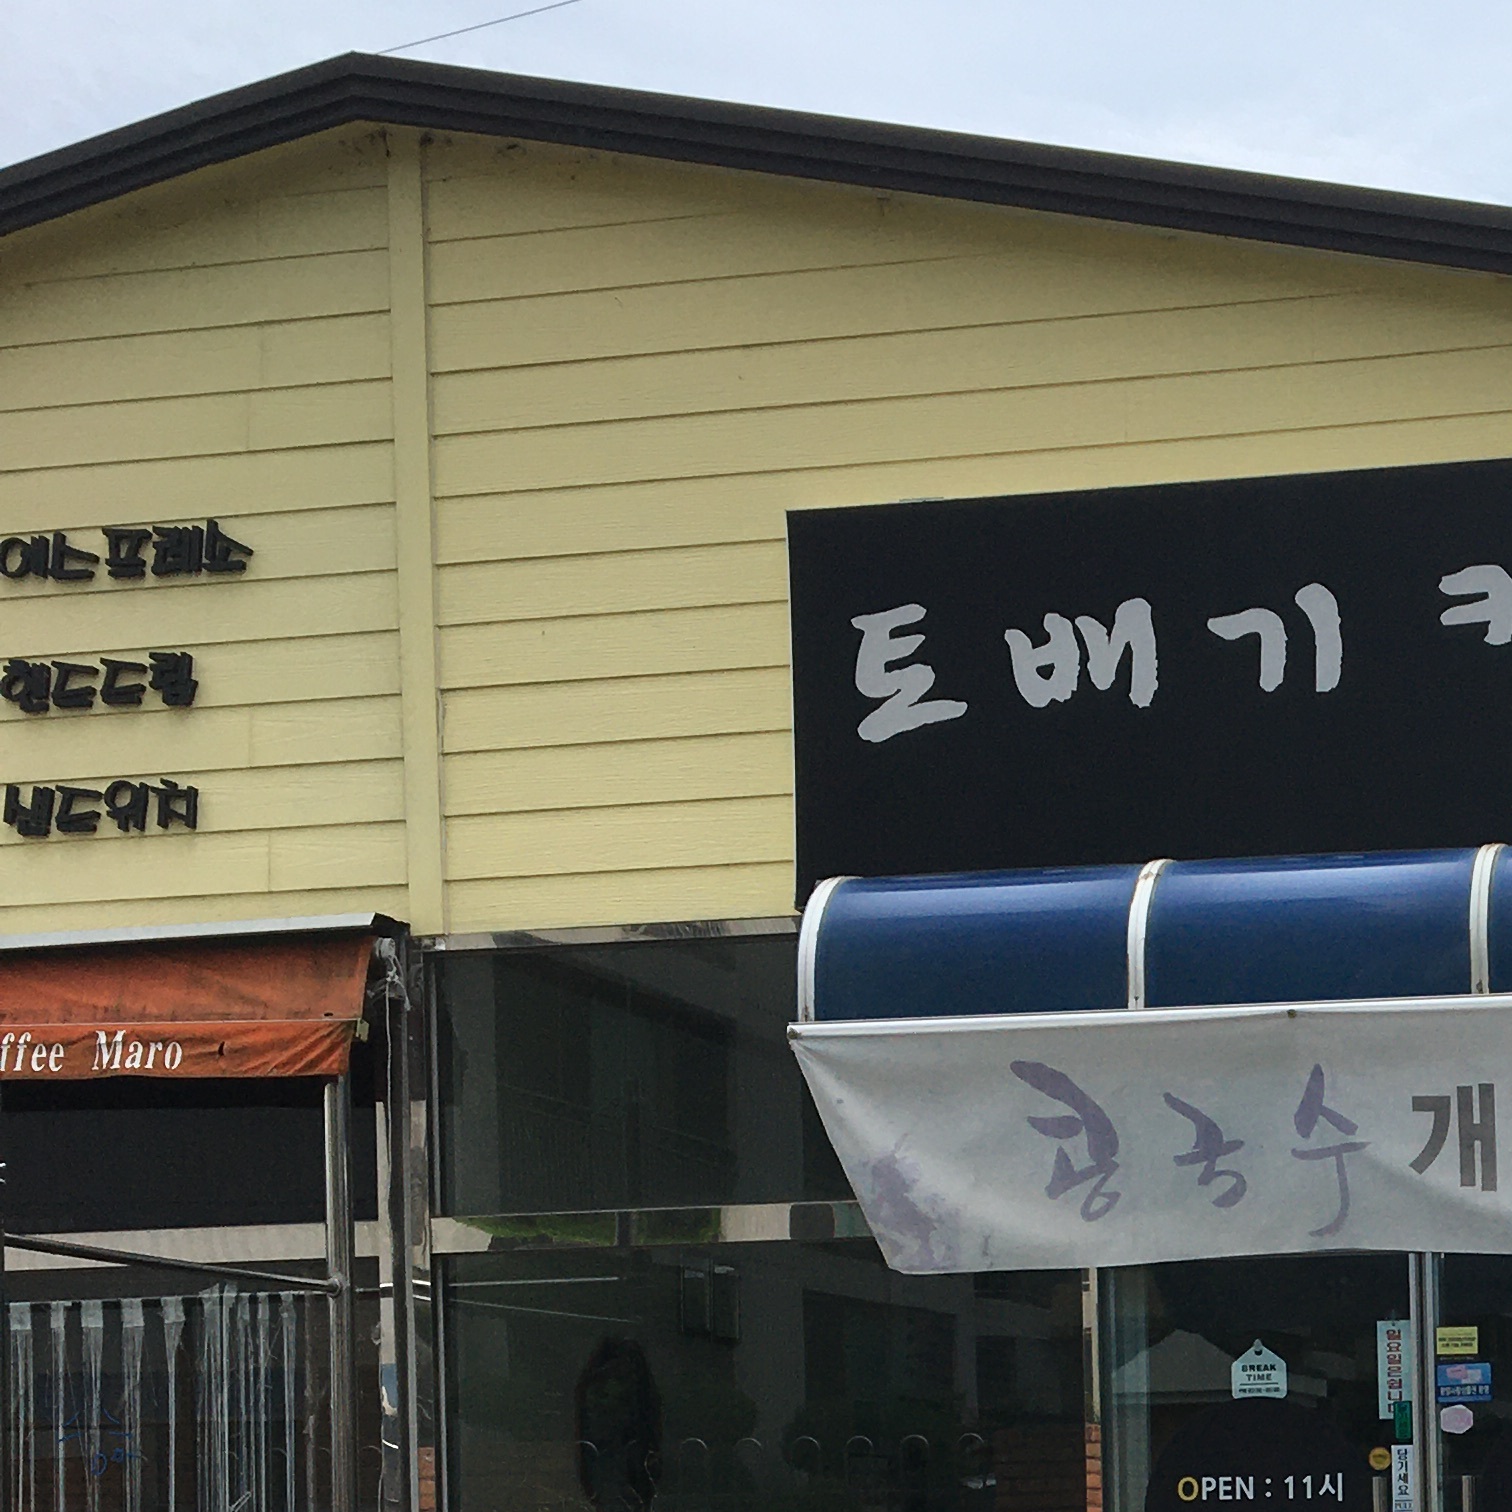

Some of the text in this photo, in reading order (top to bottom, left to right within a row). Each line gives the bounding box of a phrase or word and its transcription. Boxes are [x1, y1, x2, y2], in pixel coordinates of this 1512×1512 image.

[850, 583, 1344, 743] 토배기
[92, 1029, 183, 1071] Maro
[1010, 1059, 1369, 1238] 콩국수
[1241, 1364, 1276, 1372] BREAK
[1246, 1373, 1272, 1381] TIME
[1177, 1475, 1255, 1502] OPEN
[1283, 1472, 1344, 1503] 11시
[1397, 1448, 1409, 1496] 당기세요
